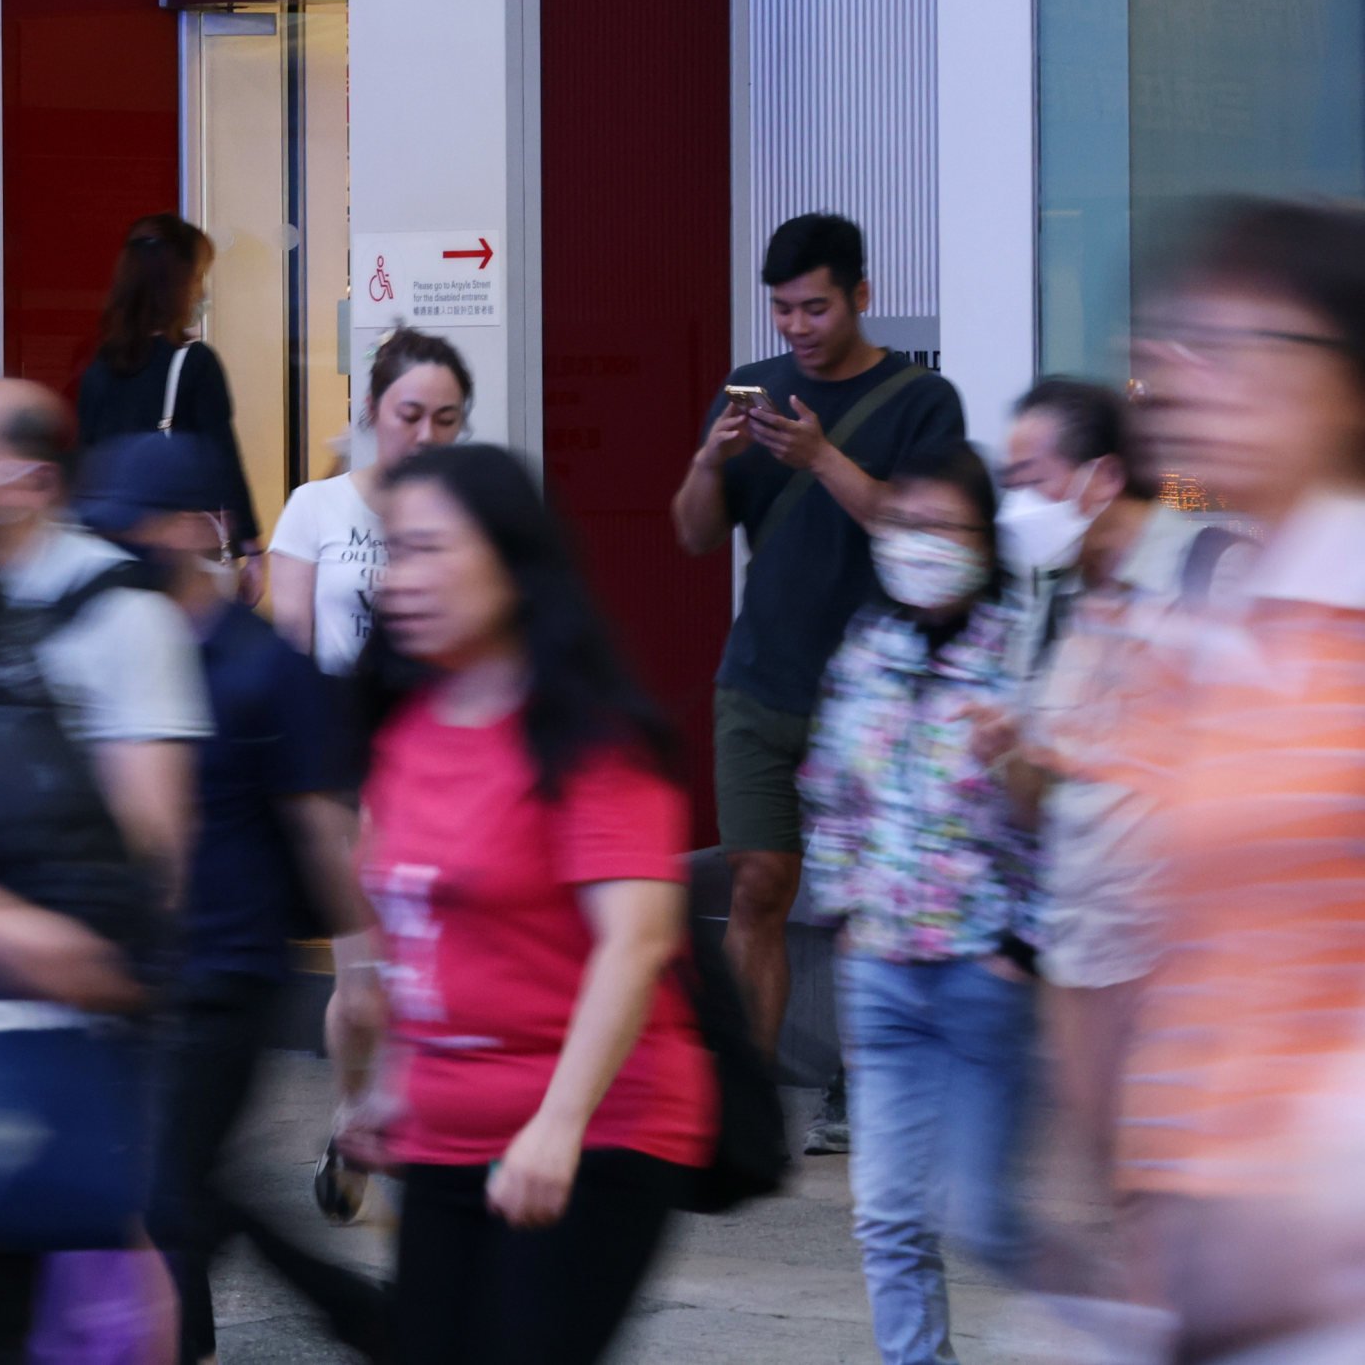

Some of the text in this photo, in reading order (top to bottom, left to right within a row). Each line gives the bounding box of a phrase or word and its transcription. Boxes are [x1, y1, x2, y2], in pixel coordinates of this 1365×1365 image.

[413, 280, 491, 292] Please go to Argyle Street
[413, 293, 422, 302] for
[423, 294, 433, 302] the
[434, 293, 460, 302] disabled
